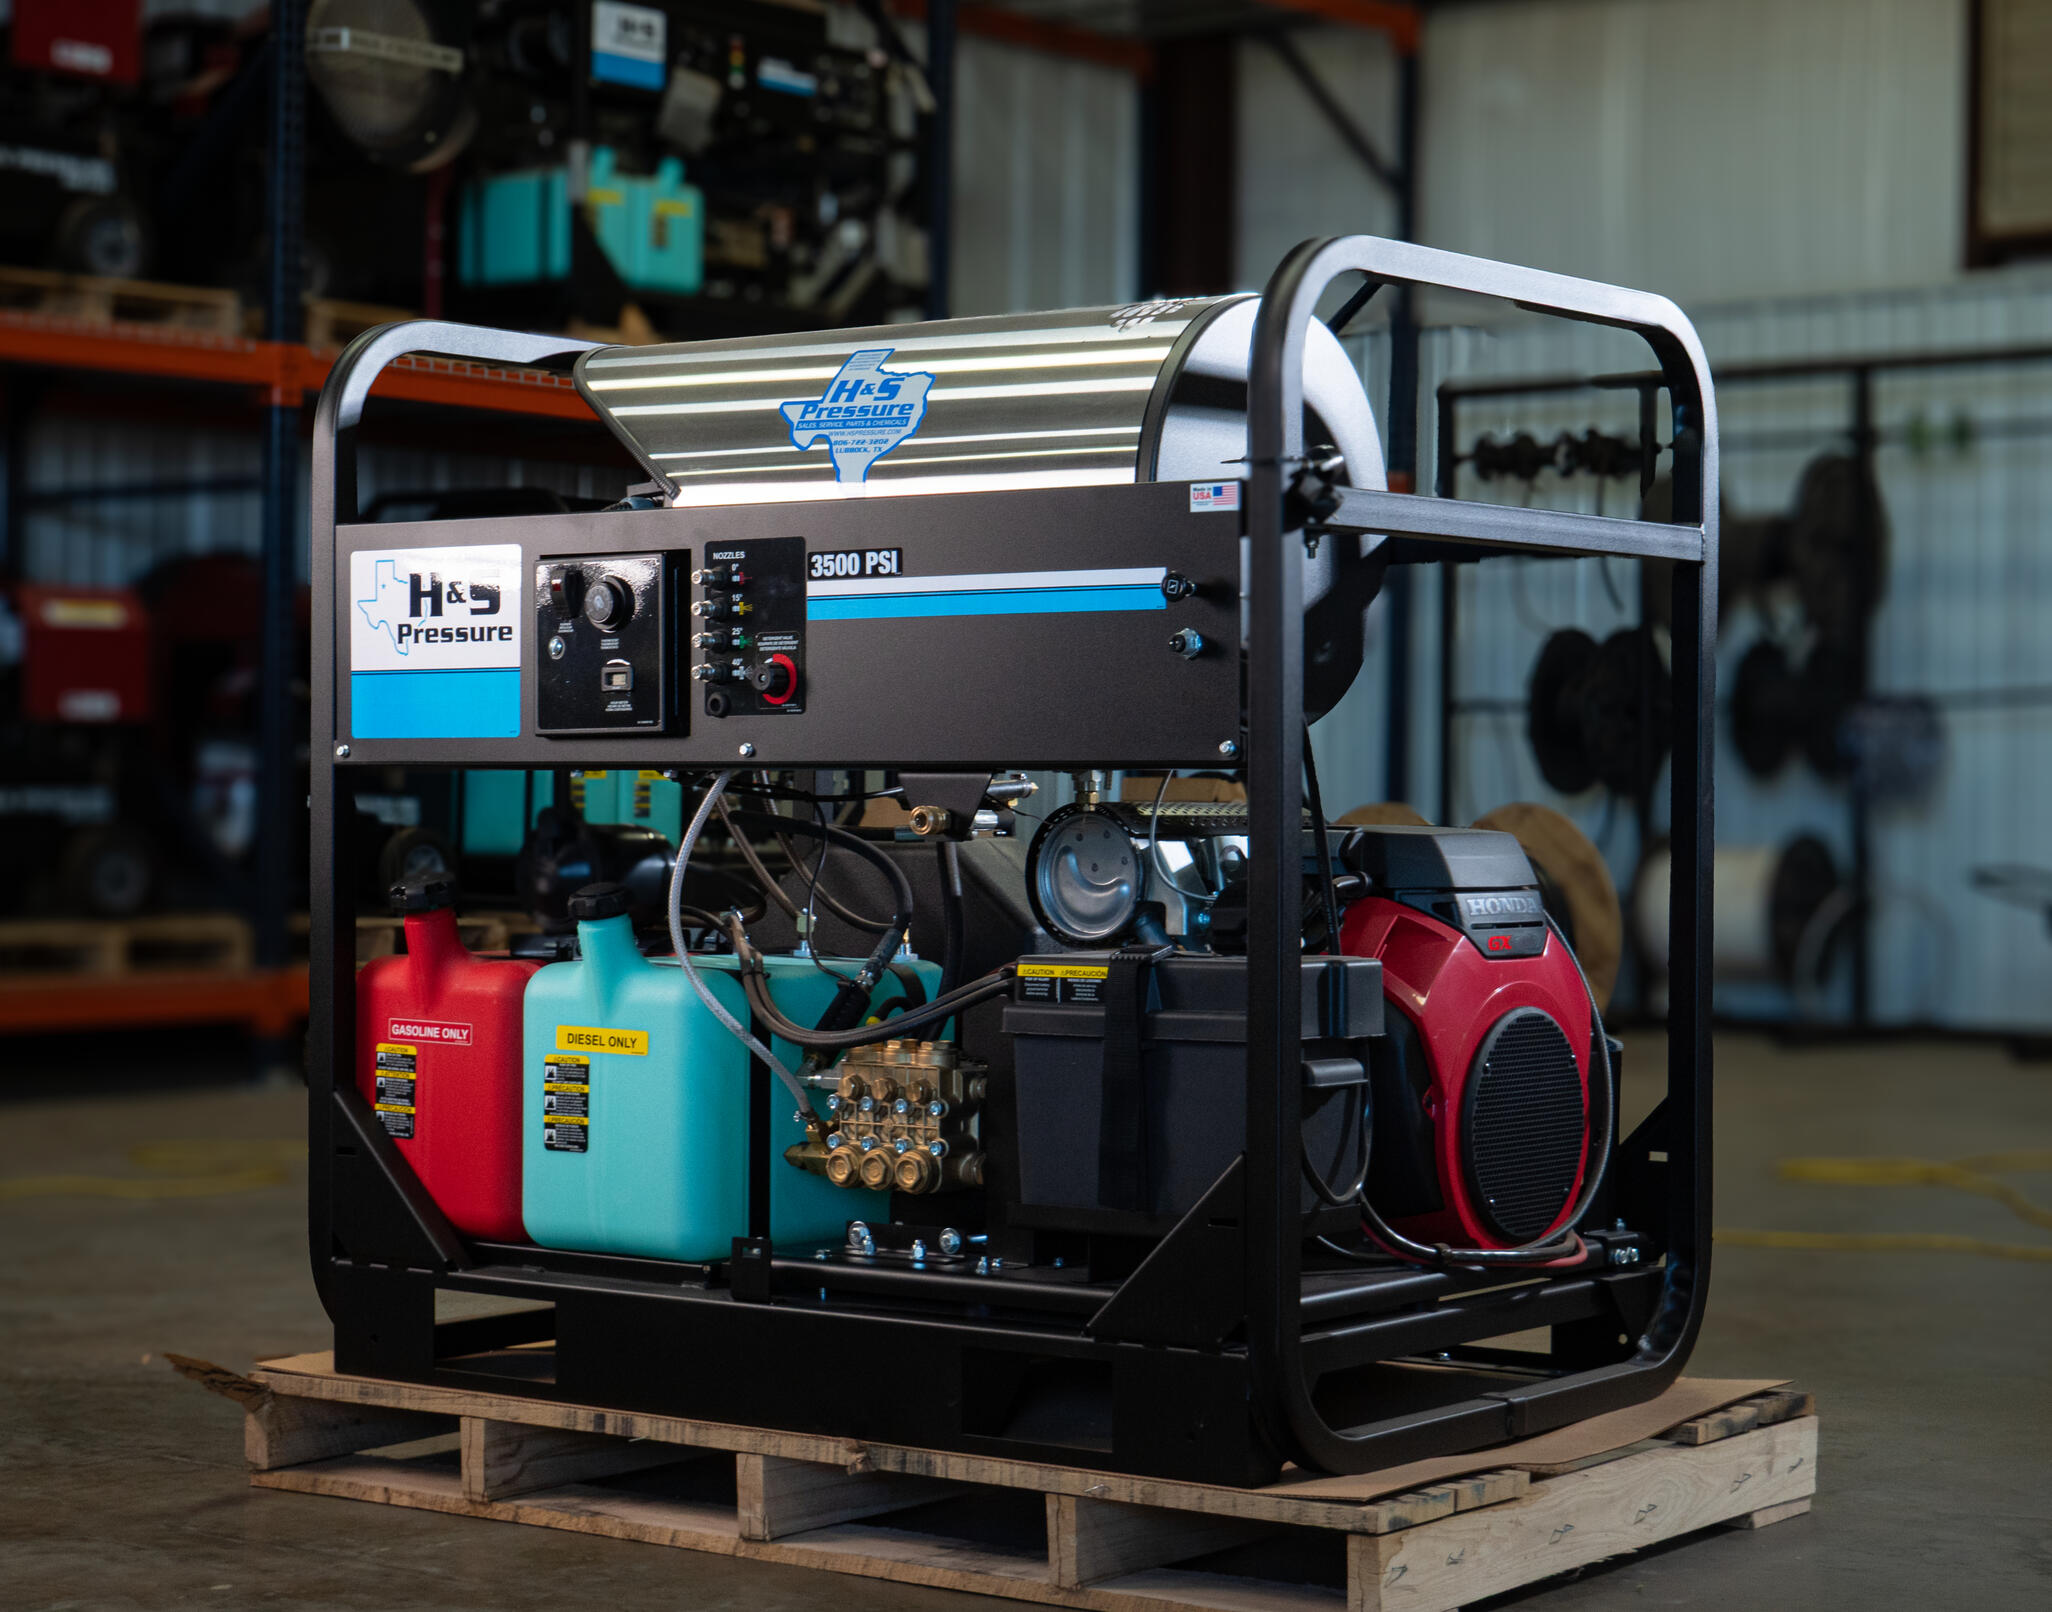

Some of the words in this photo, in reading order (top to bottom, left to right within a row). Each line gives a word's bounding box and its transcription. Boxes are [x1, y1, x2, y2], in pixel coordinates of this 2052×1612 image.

[830, 377, 905, 403] H&S
[800, 403, 914, 419] Pressure
[1193, 491, 1211, 500] USA
[713, 551, 745, 560] NOZZLES
[811, 553, 860, 577] 3500
[866, 551, 898, 575] PSI
[409, 568, 501, 617] H&S
[397, 622, 513, 645] Pressure
[1467, 897, 1539, 915] HONDA
[1488, 934, 1512, 951] GX
[392, 1024, 440, 1038] GASOLINE
[442, 1028, 469, 1040] ONLY
[567, 1033, 605, 1046] DIESEL
[608, 1036, 638, 1048] ONLY
